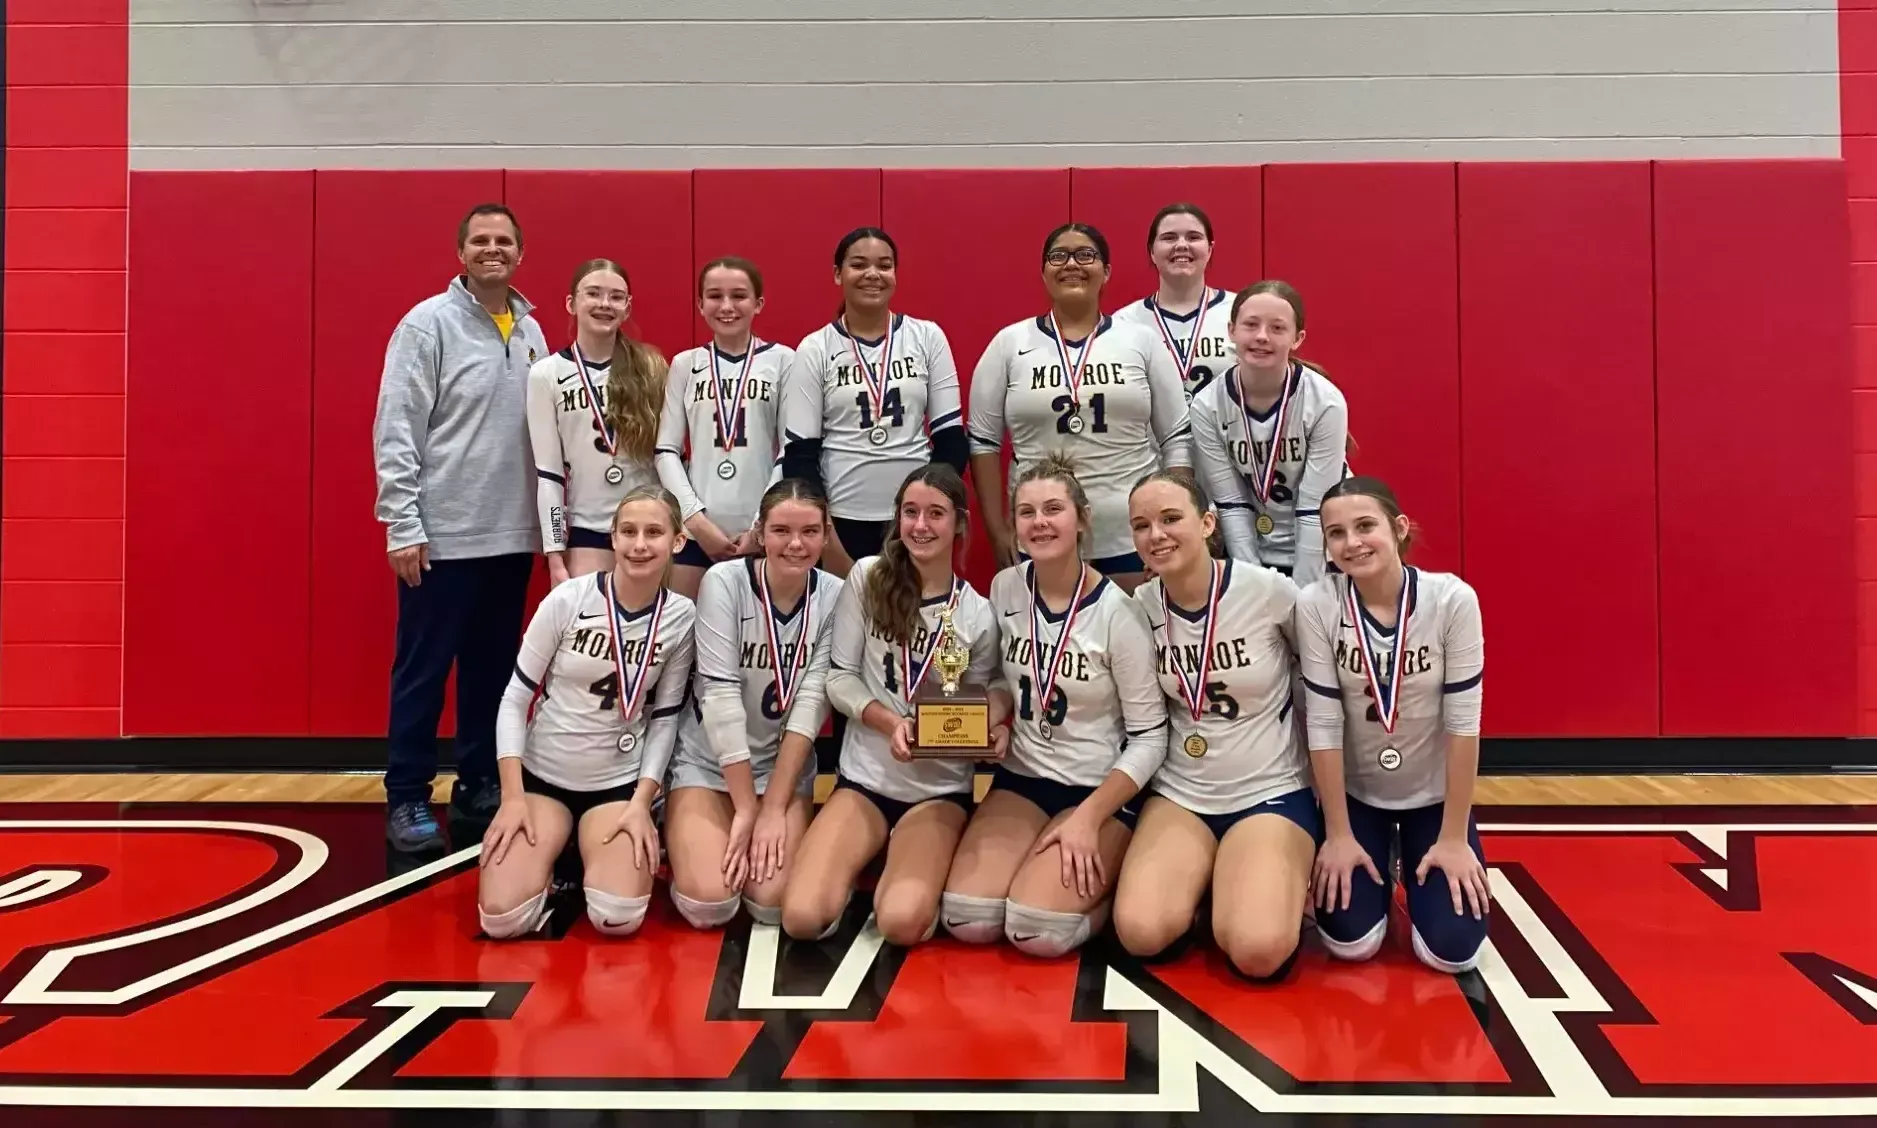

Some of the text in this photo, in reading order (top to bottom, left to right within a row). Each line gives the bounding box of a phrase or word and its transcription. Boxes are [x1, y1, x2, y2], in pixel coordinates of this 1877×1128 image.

[693, 378, 772, 402] MONOE
[1031, 363, 1125, 390] MOROE
[856, 387, 905, 429] 14
[1051, 393, 1108, 434] 21
[739, 641, 816, 669] MORO
[589, 671, 621, 710] 4
[1018, 674, 1068, 726] 19
[1176, 680, 1239, 720] 5
